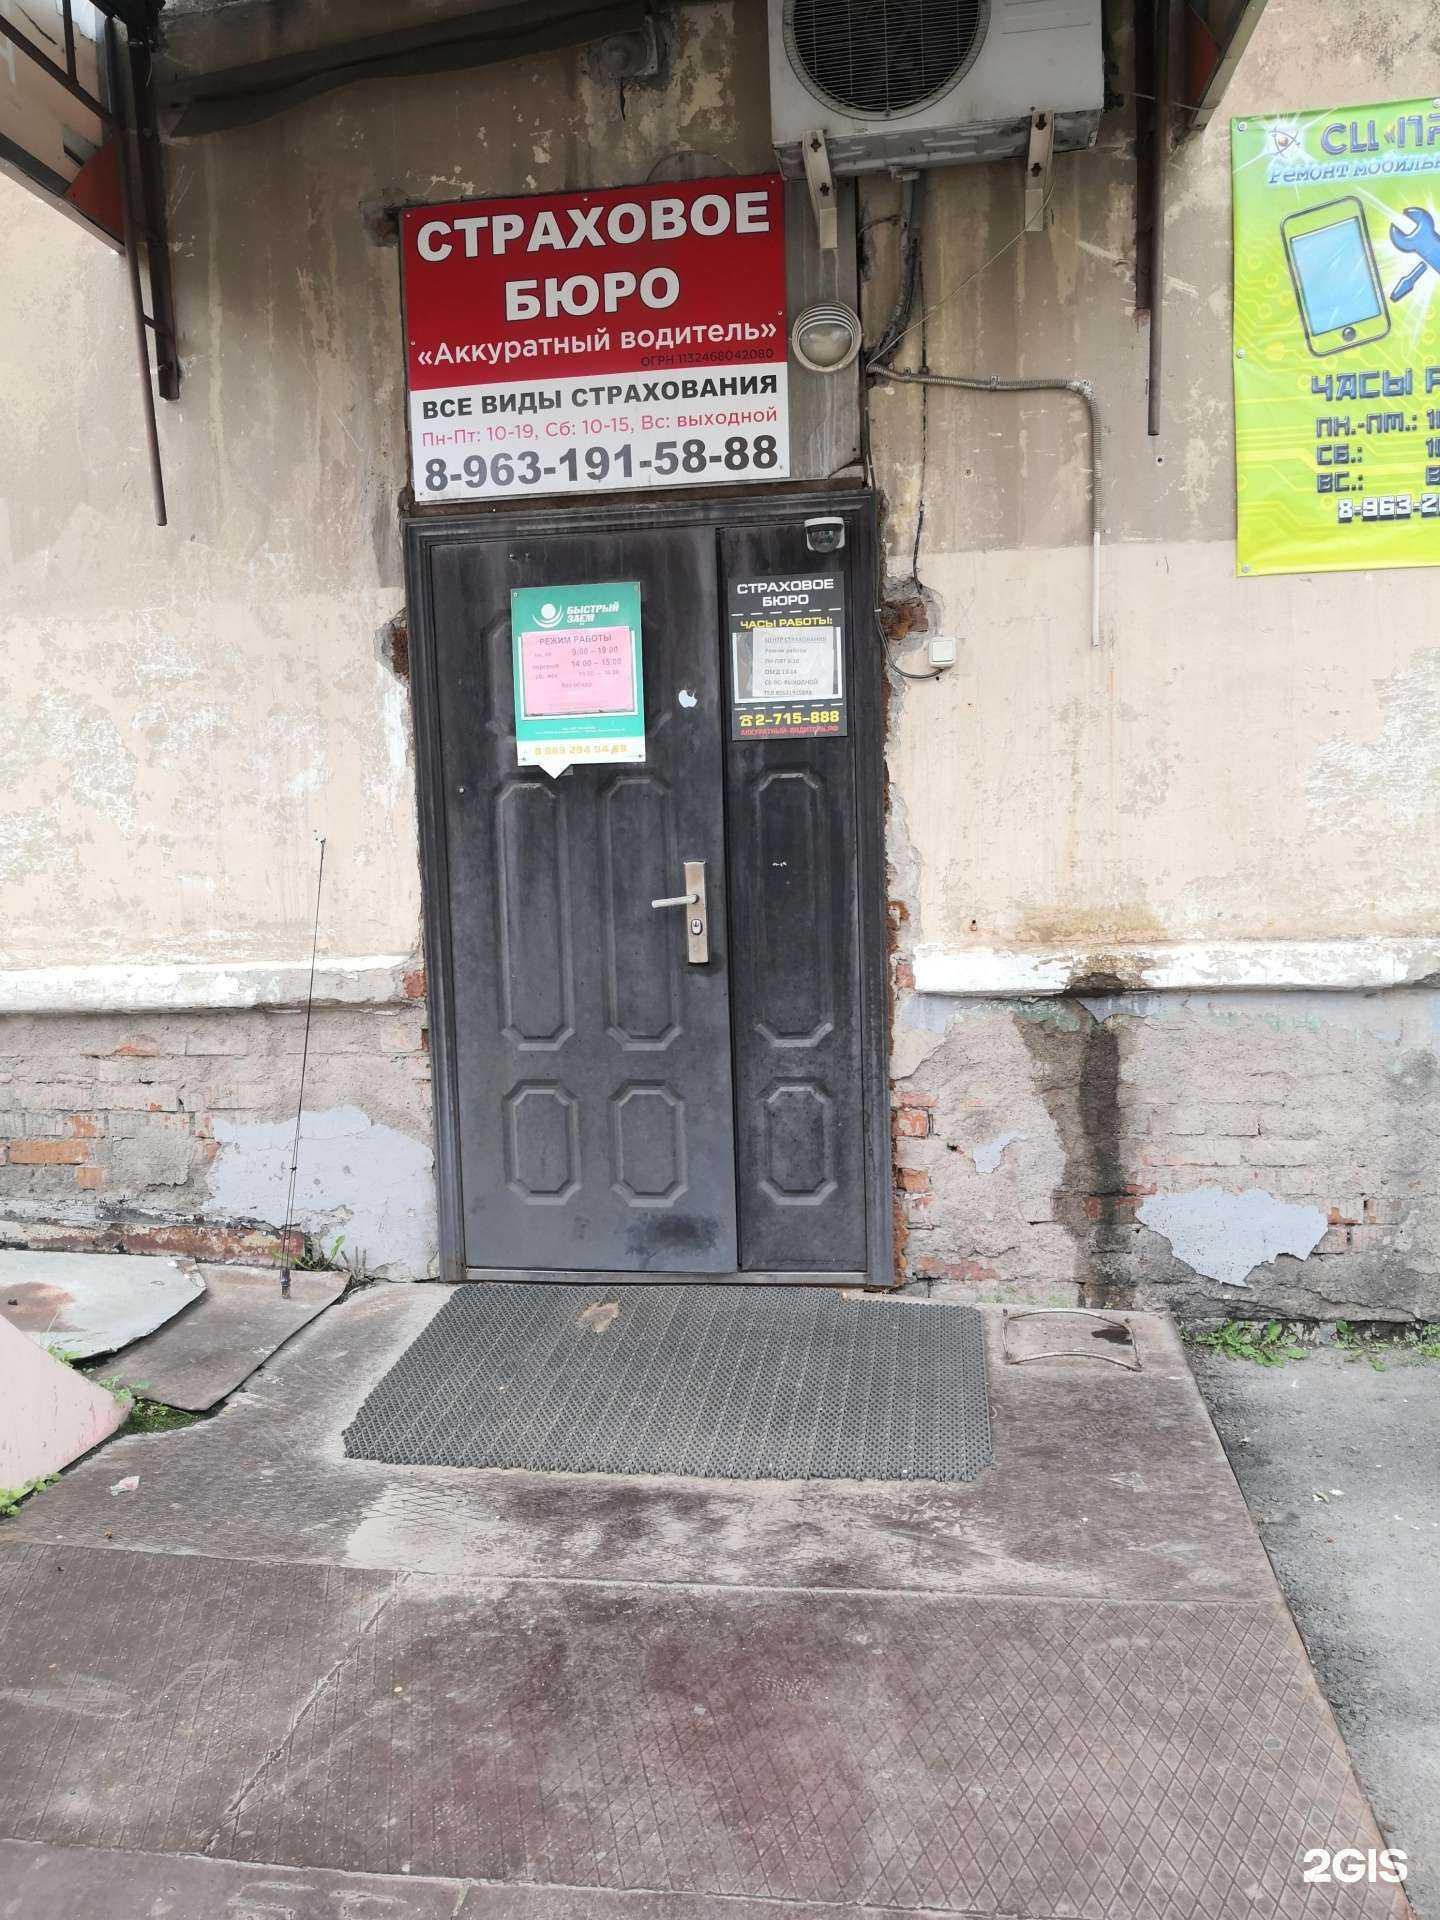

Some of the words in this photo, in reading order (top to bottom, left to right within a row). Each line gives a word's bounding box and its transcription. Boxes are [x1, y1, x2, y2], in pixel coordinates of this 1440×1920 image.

[417, 191, 770, 262] СТРАХОВОЕ
[505, 267, 681, 322] БЮРО
[417, 327, 611, 368] «Аккуратный
[620, 321, 777, 350] водитель»
[641, 355, 674, 367] ОГРН
[678, 348, 774, 364] 1132468042080
[422, 396, 473, 420] ВСЕ
[481, 389, 562, 415] ВИДЫ
[571, 374, 778, 408] СТРАХОВАНИЯ
[1311, 368, 1413, 401] ЧАСЫ
[422, 428, 481, 447] Пн-Пт:
[486, 423, 539, 443] 10-19,
[546, 419, 576, 438] Сб:
[582, 416, 635, 436] 10-15,
[642, 413, 670, 431] Вс:
[677, 406, 778, 430] выходной
[425, 435, 779, 492] 8-963-191-58-88
[1337, 493, 1440, 523] 8-963-2
[736, 579, 834, 594] СТРАХОВОЕ
[762, 594, 810, 607] БЮРО
[567, 601, 620, 615] БЫСТРЫЙ
[740, 618, 777, 630] ЧАСЫ
[779, 616, 833, 628] РАБОТЫ:
[539, 635, 572, 646] РЕЖИМ
[573, 634, 612, 643] РАБОТЫ
[755, 710, 840, 726] 2-715-888
